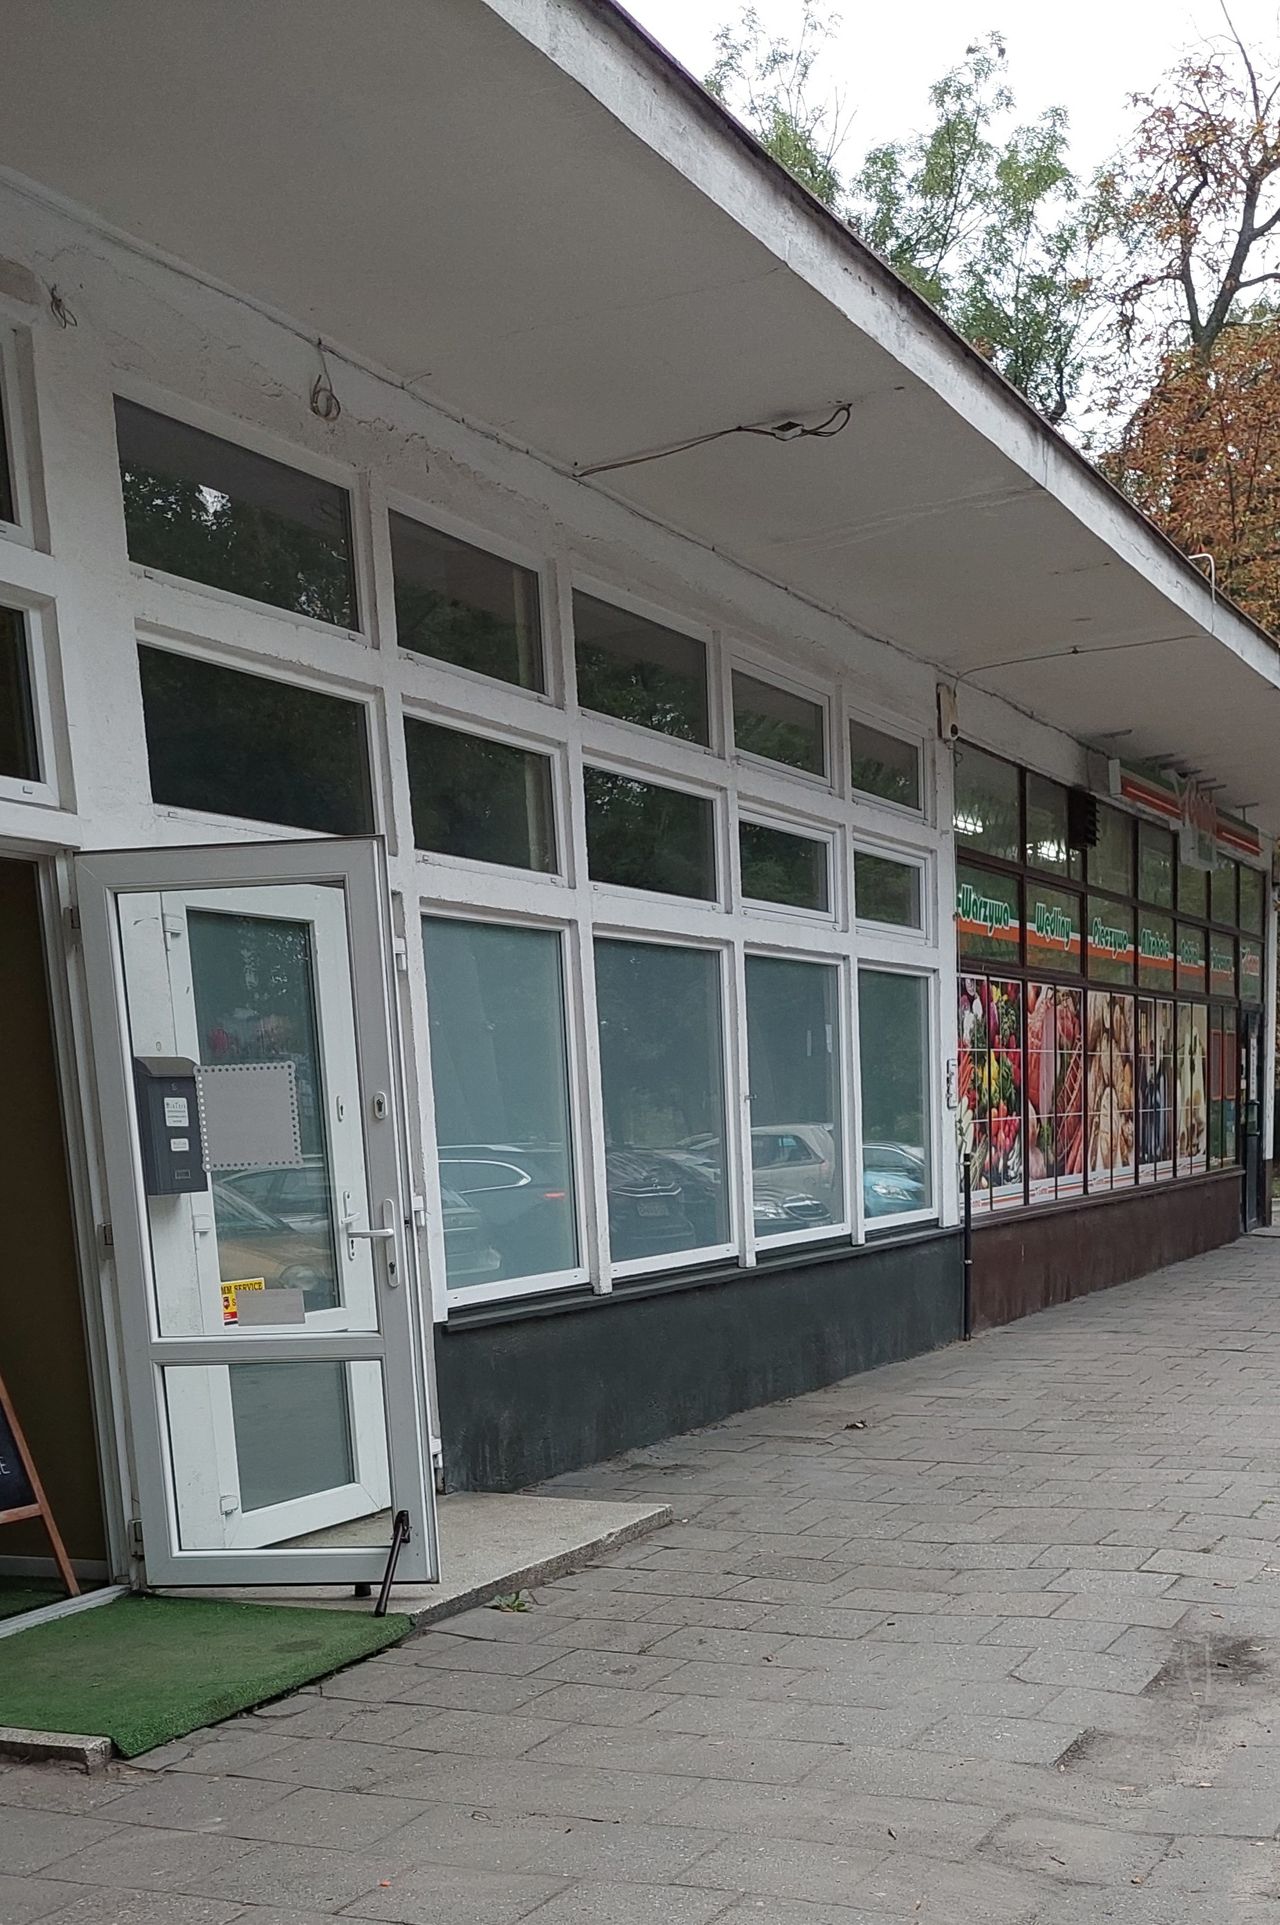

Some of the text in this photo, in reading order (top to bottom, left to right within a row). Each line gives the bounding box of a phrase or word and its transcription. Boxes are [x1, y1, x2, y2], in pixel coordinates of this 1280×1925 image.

[961, 884, 1010, 936] Warzywa
[1036, 902, 1071, 951] Wędliny
[1093, 917, 1128, 960] Pieczywo
[234, 1282, 262, 1291] SERVICE
